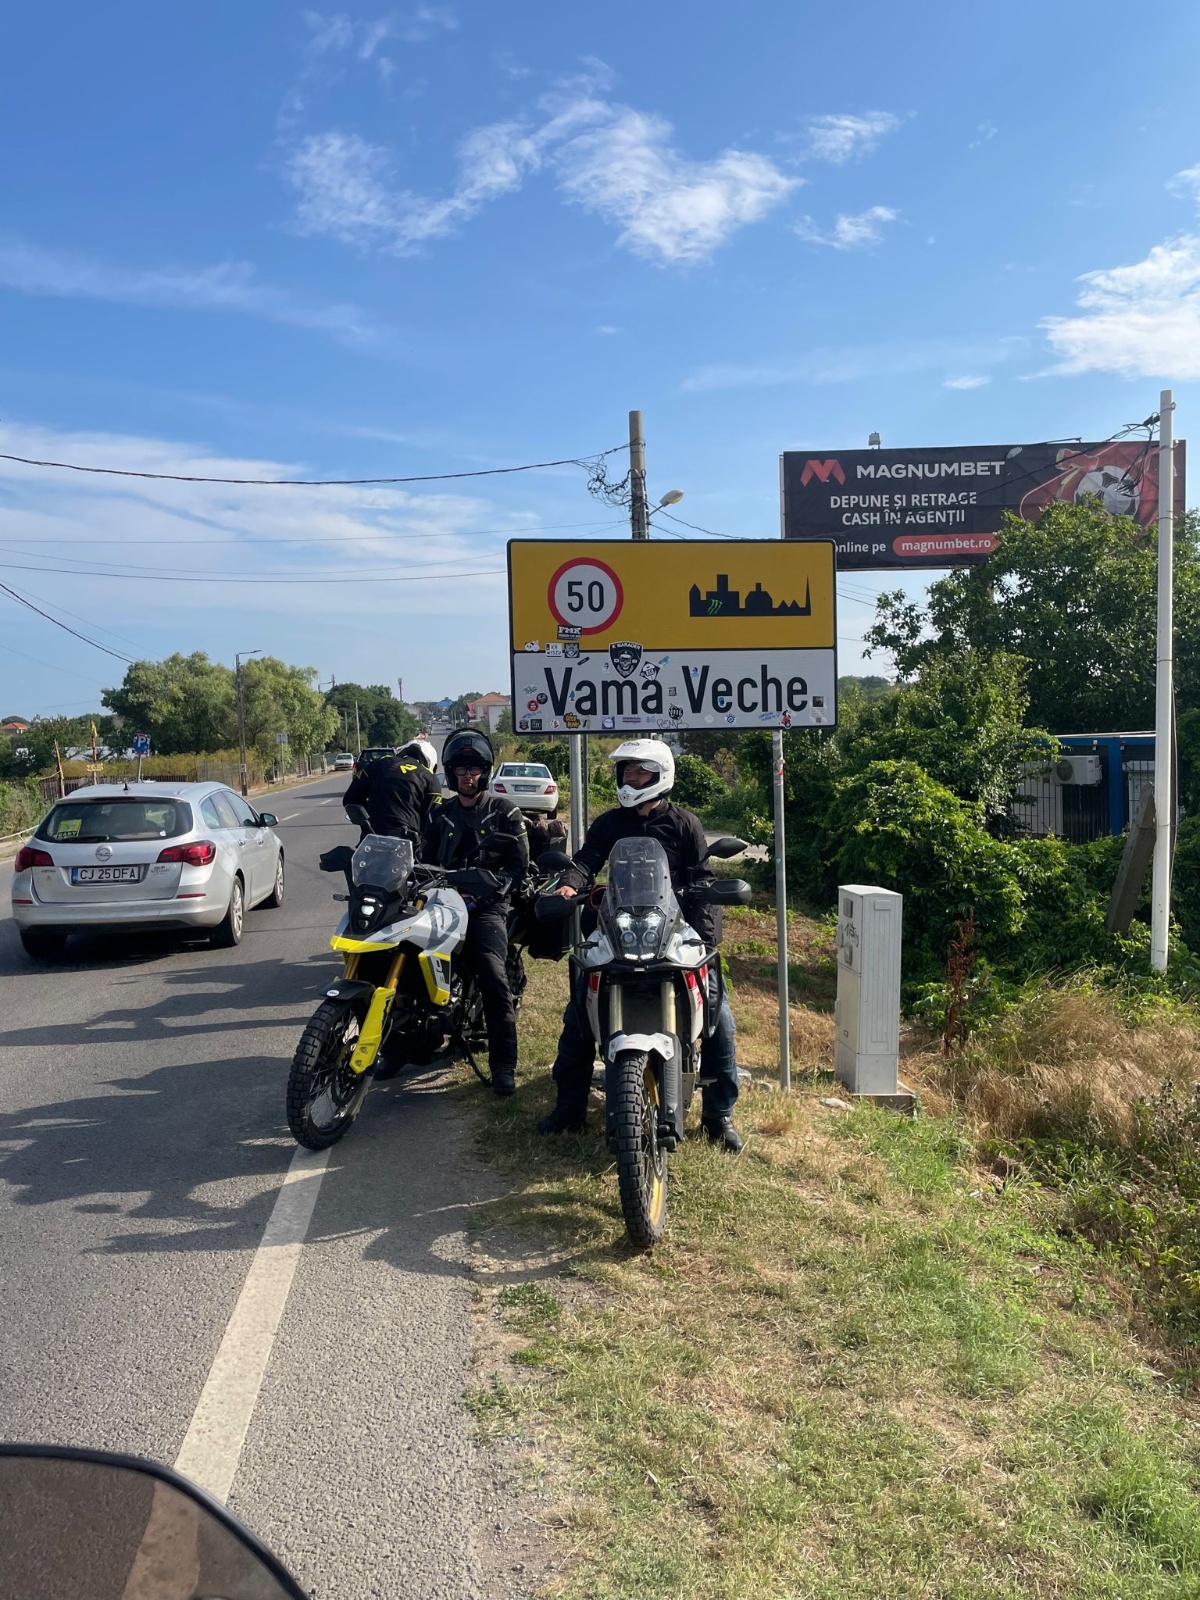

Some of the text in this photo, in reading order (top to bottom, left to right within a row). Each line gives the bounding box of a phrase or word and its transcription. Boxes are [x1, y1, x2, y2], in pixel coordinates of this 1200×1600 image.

[856, 461, 1005, 479] MAGNUMBET
[830, 494, 890, 509] DEPUNE
[911, 491, 977, 507] RETRAGE
[842, 512, 880, 526] CASH
[905, 509, 966, 526] AGENȚII
[872, 542, 887, 555] pe
[901, 538, 991, 554] magnumbet.ro
[567, 580, 605, 613] 50
[543, 663, 808, 717] Vama Veche
[137, 736, 147, 748] P
[79, 868, 136, 880] CJ 25 DFA
